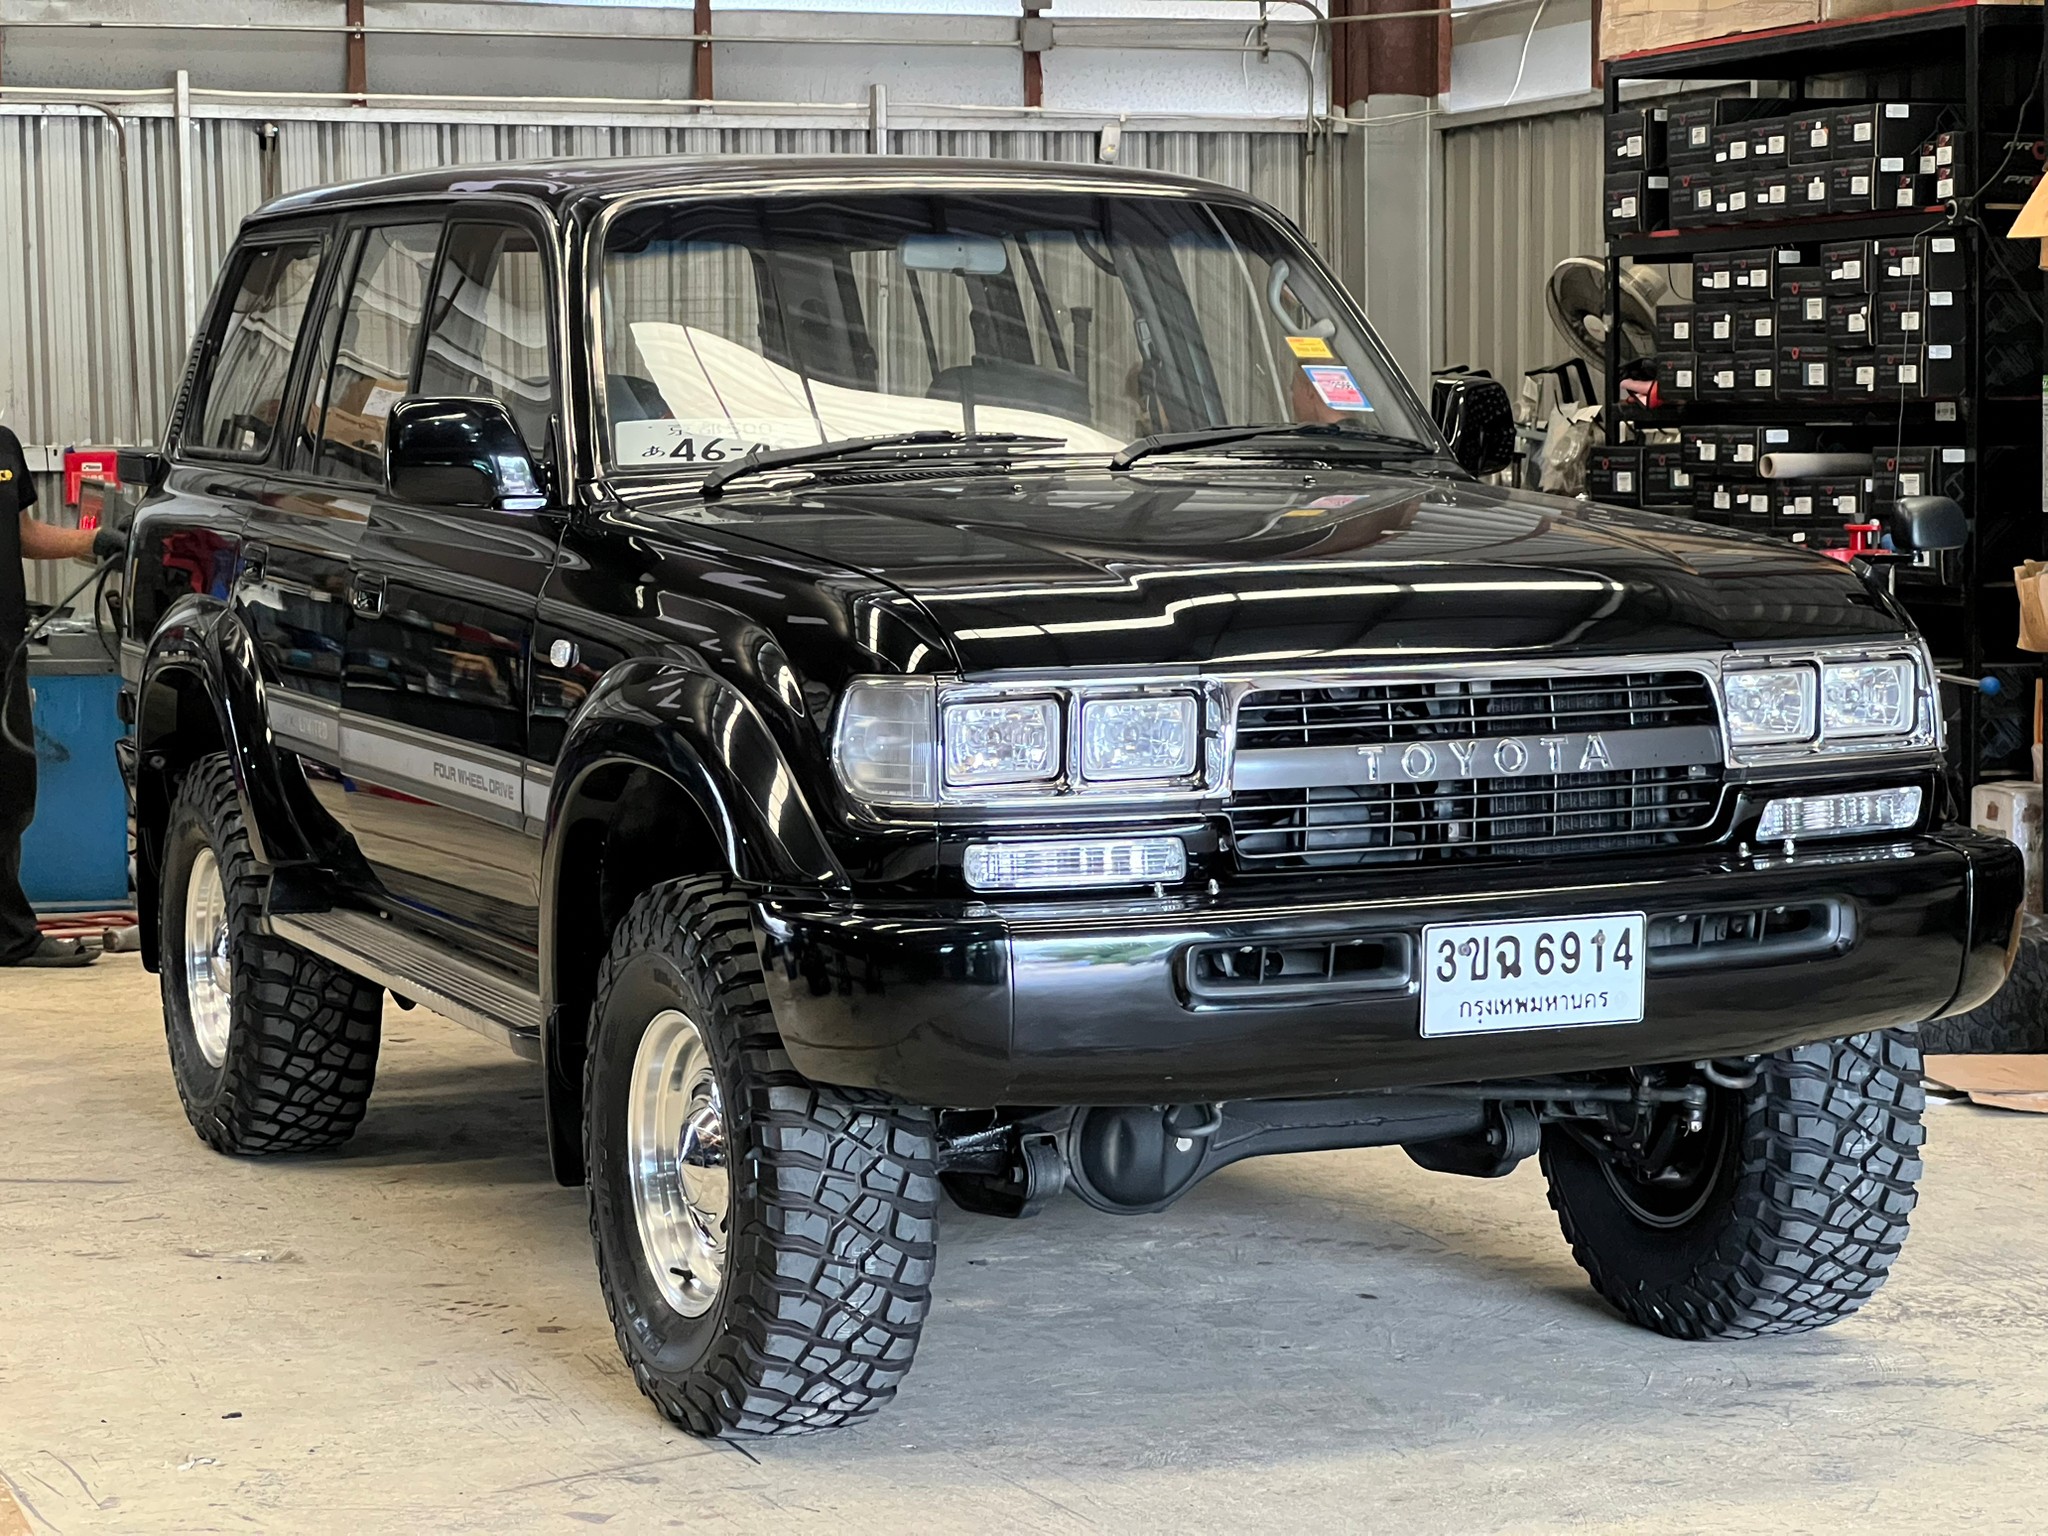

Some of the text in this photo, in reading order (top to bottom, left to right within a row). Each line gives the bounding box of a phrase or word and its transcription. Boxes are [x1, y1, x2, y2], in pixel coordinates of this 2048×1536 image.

[1357, 734, 1614, 782] TOYOTA
[433, 761, 514, 801] FOUR WHEEL DRIVE
[1534, 927, 1633, 975] 6914
[1459, 991, 1609, 1024] กรุงเทพมหานคร
